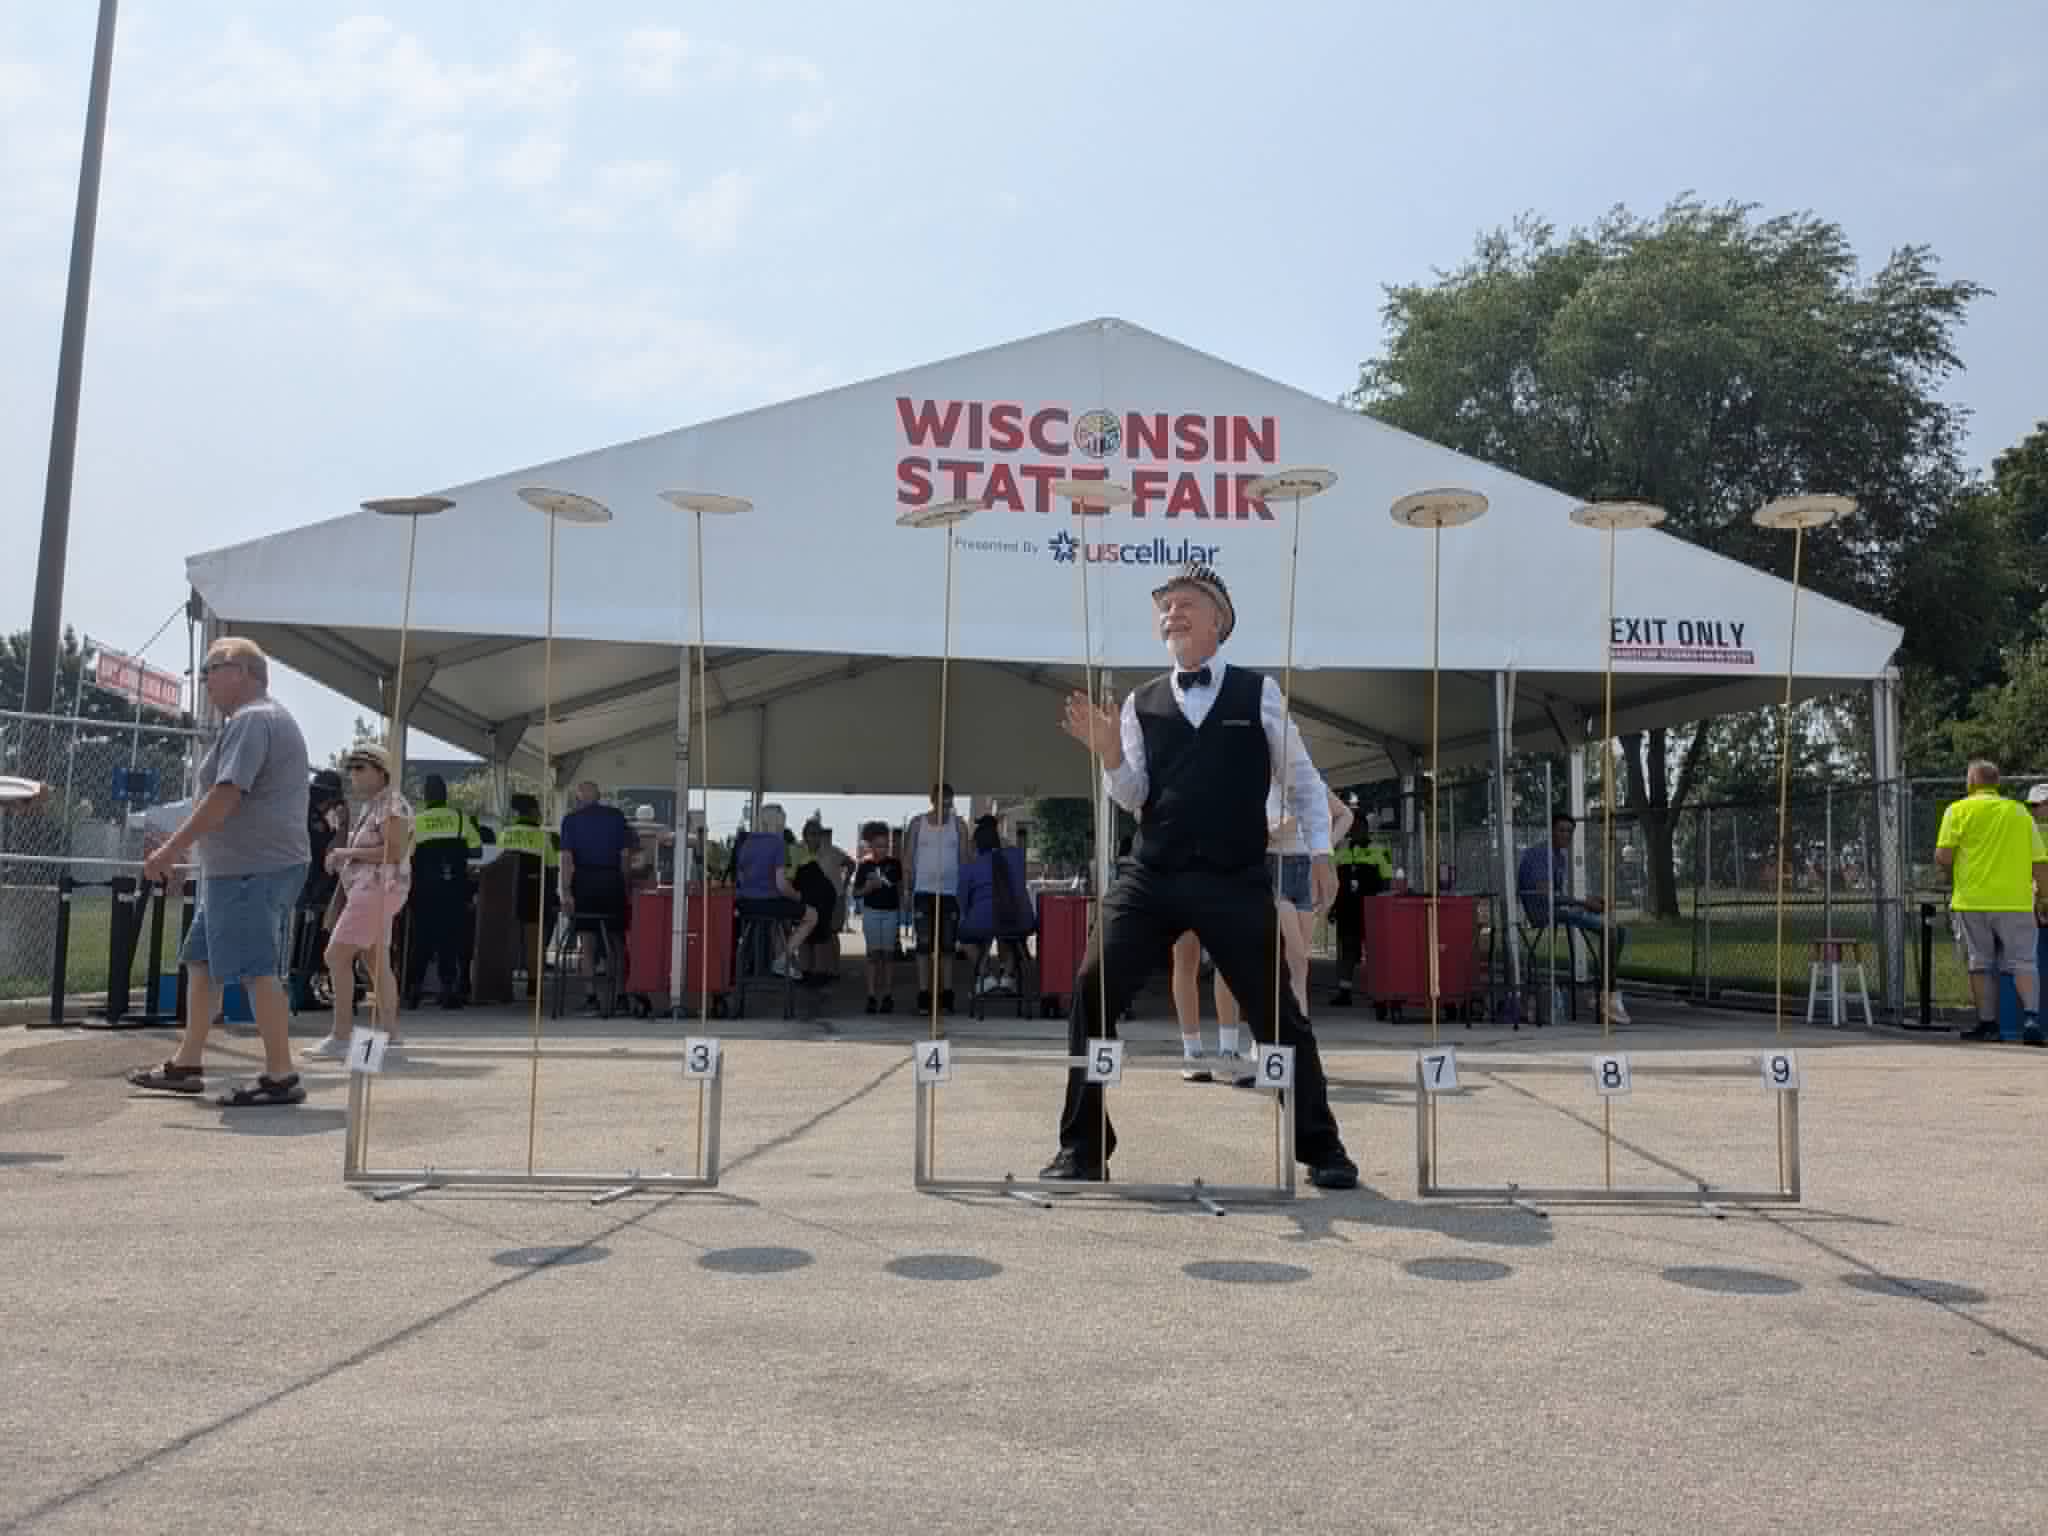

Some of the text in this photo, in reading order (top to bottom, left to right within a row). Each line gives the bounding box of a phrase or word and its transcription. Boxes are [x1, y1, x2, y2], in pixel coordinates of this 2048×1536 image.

[896, 397, 1276, 463] WISCONSIN
[897, 456, 1276, 520] STATE FAIR
[1610, 617, 1744, 647] EXIT ONLY
[363, 1038, 373, 1064] 1
[691, 1046, 709, 1072] 3
[925, 1047, 942, 1073] 4
[1095, 1047, 1113, 1074] 5
[1266, 1054, 1283, 1079] 6
[1424, 1056, 1445, 1083] 7
[1603, 1061, 1621, 1087] 8
[1771, 1056, 1789, 1082] 9
